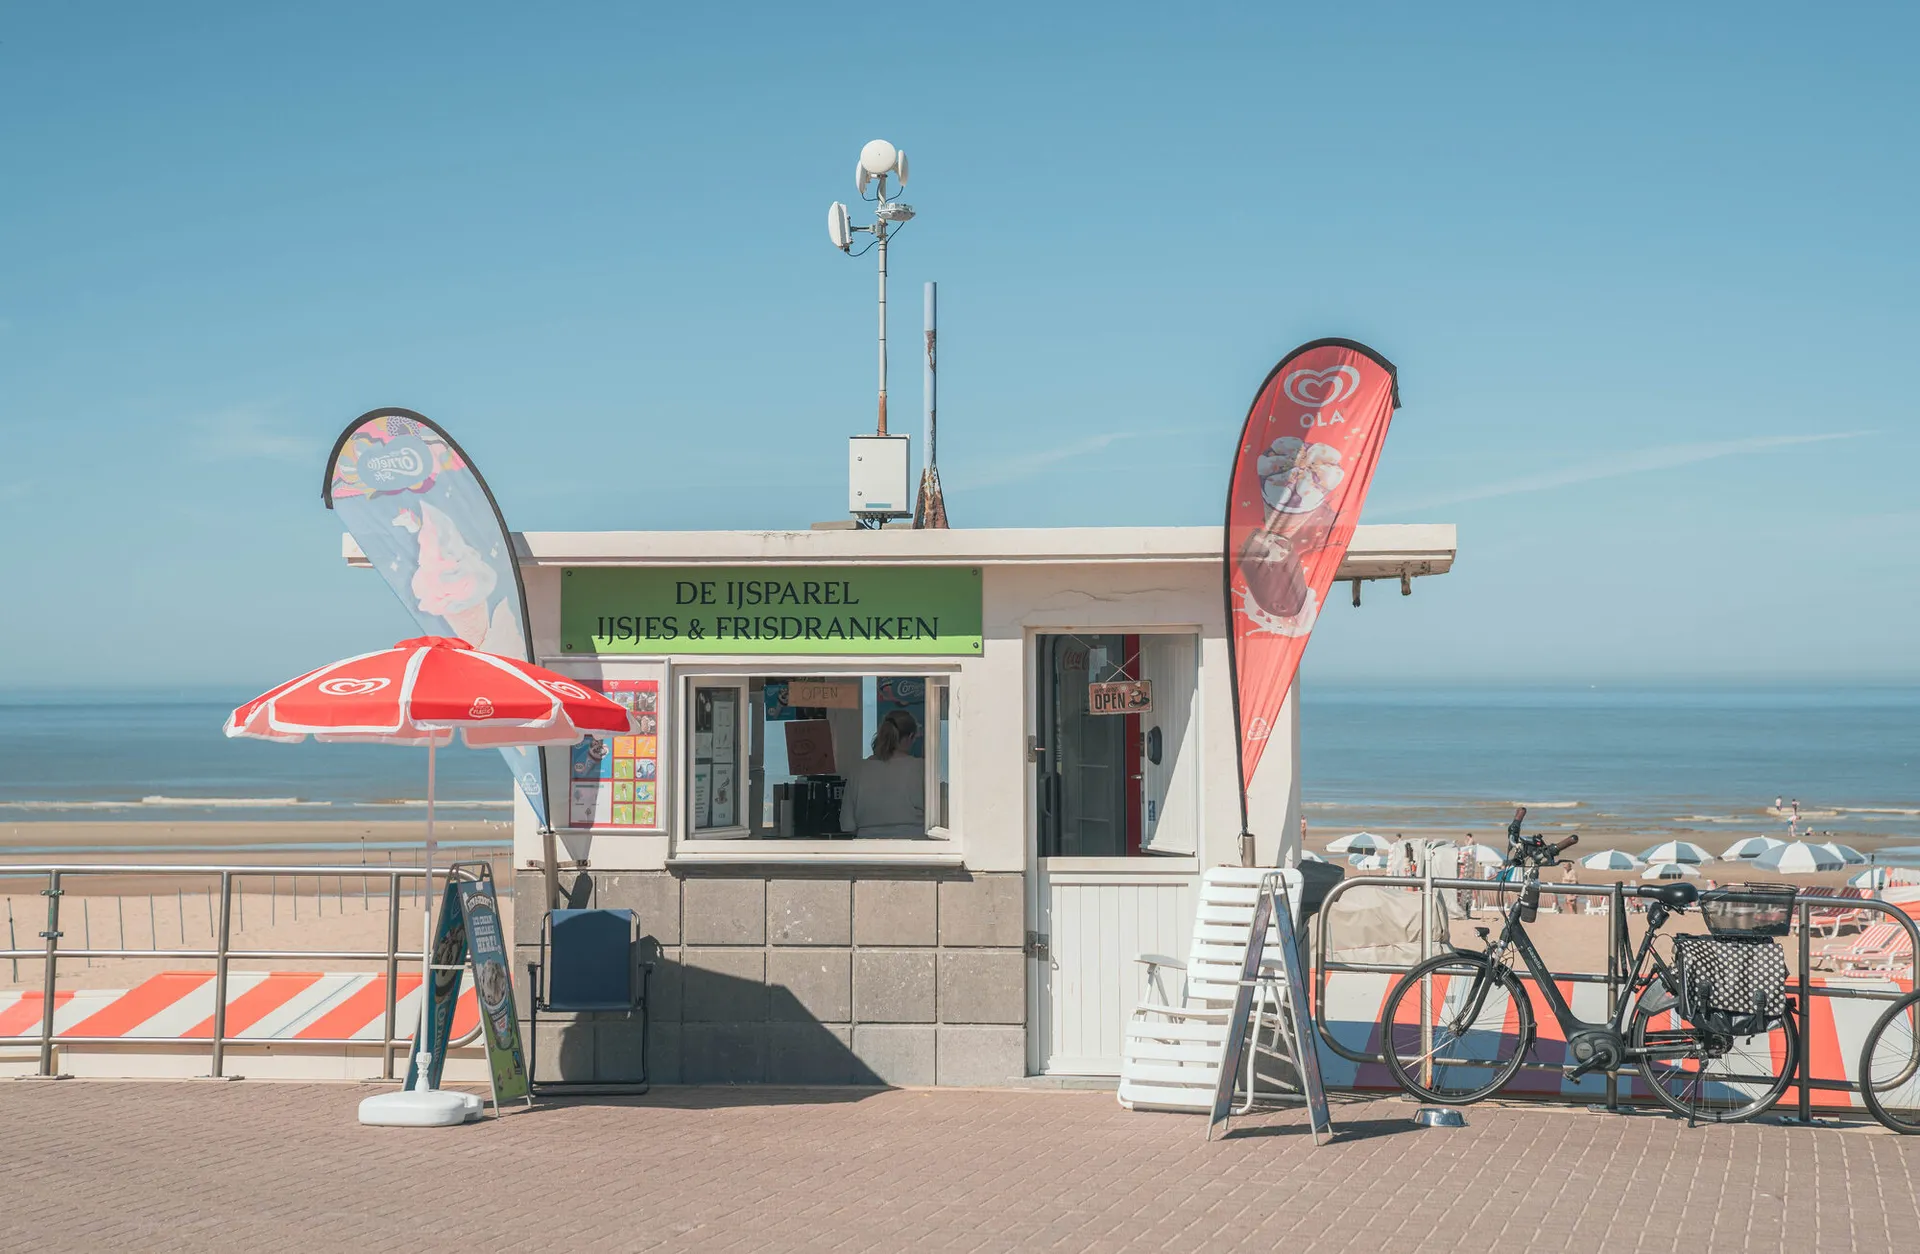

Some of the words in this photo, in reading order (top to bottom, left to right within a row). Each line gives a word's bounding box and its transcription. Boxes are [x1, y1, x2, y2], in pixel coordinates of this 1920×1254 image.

[1300, 409, 1345, 428] OLA
[675, 581, 717, 605] DE
[726, 580, 860, 611] IJSPAREL
[597, 616, 679, 646] IJSJES
[687, 617, 705, 640] &
[715, 616, 939, 640] FRISDRANKEN
[802, 686, 838, 701] OPEN
[1094, 693, 1126, 710] OPEN
